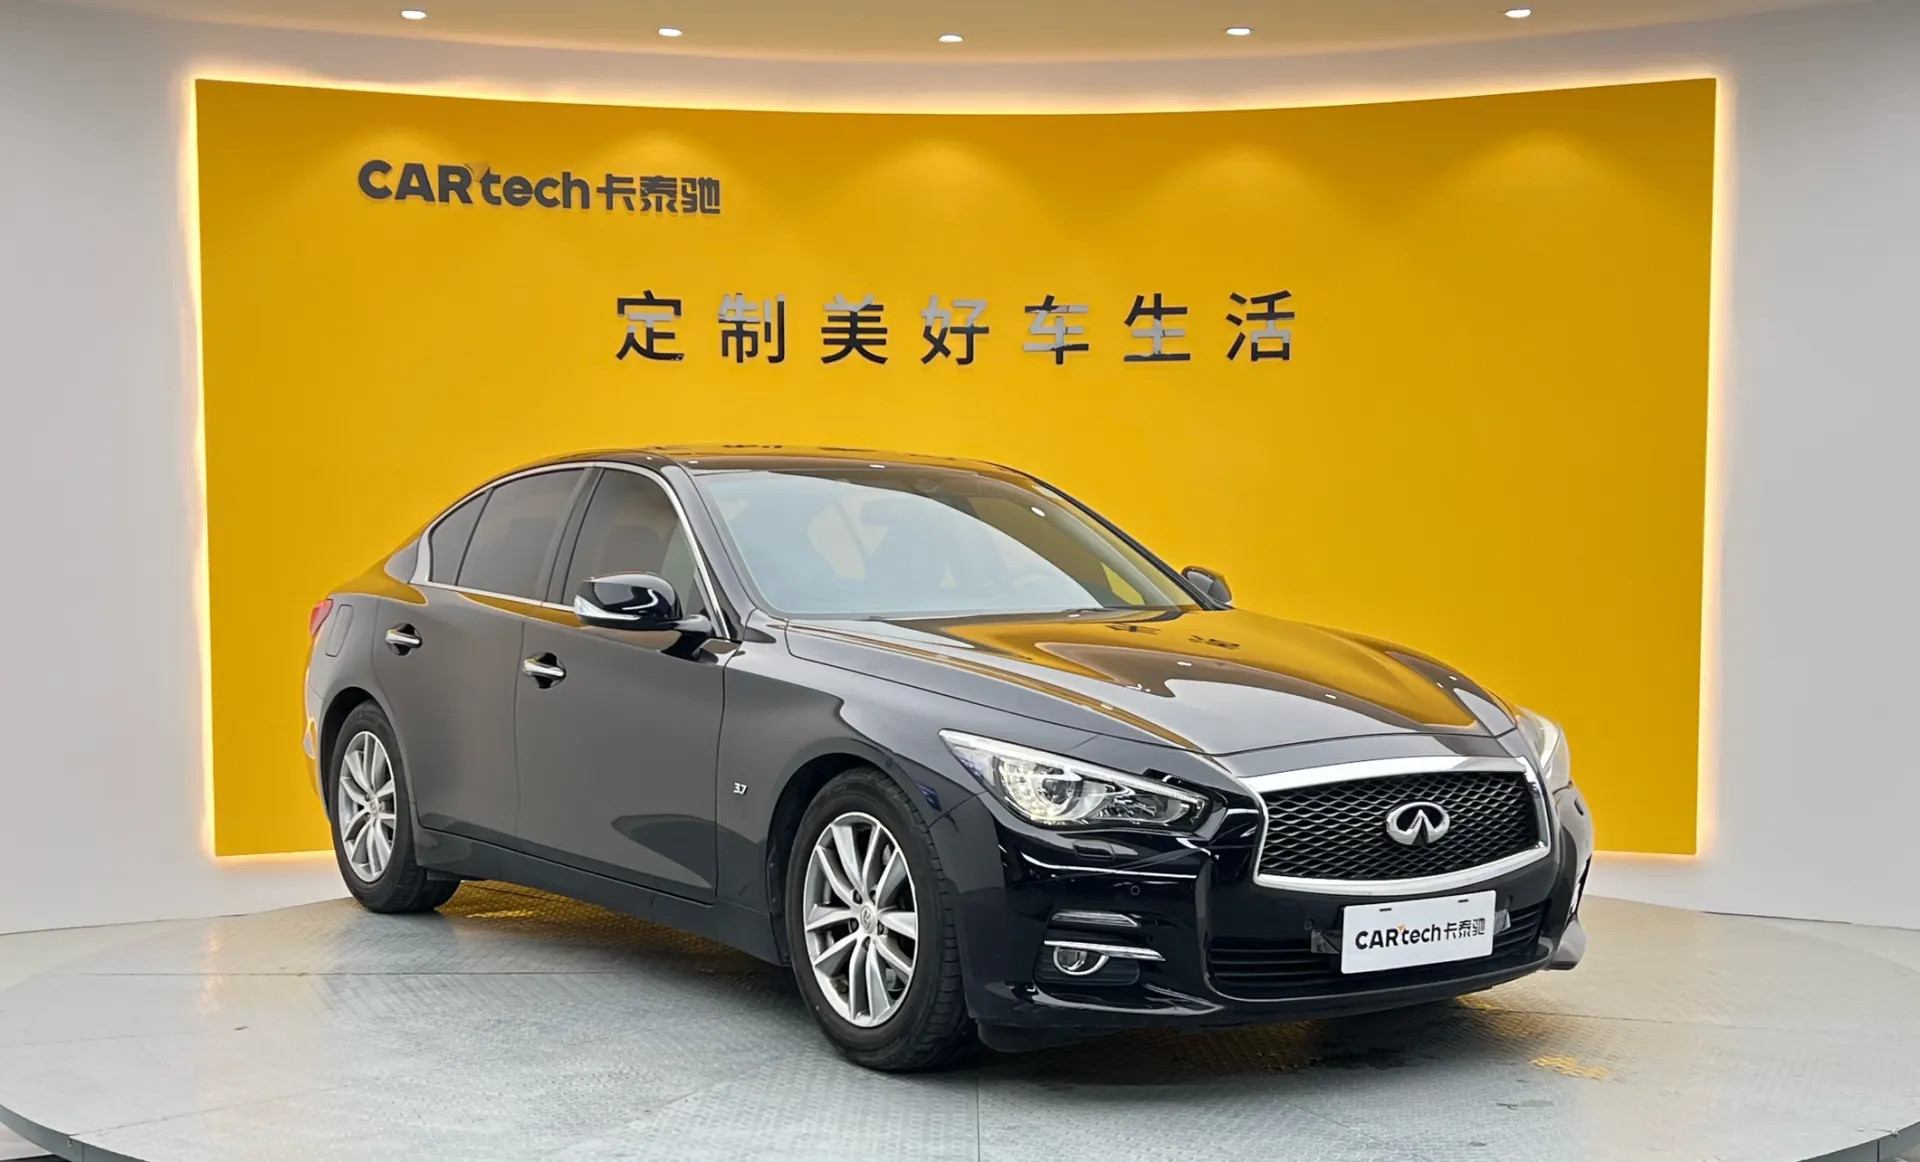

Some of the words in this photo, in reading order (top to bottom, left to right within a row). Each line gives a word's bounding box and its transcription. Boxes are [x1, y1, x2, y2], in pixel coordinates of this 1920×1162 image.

[358, 159, 590, 209] CARtech
[596, 173, 721, 214] 卡泰驰
[616, 289, 1295, 366] 定制美好车生活
[1355, 924, 1441, 949] CARtech
[1443, 918, 1486, 940] 卡泰驰
